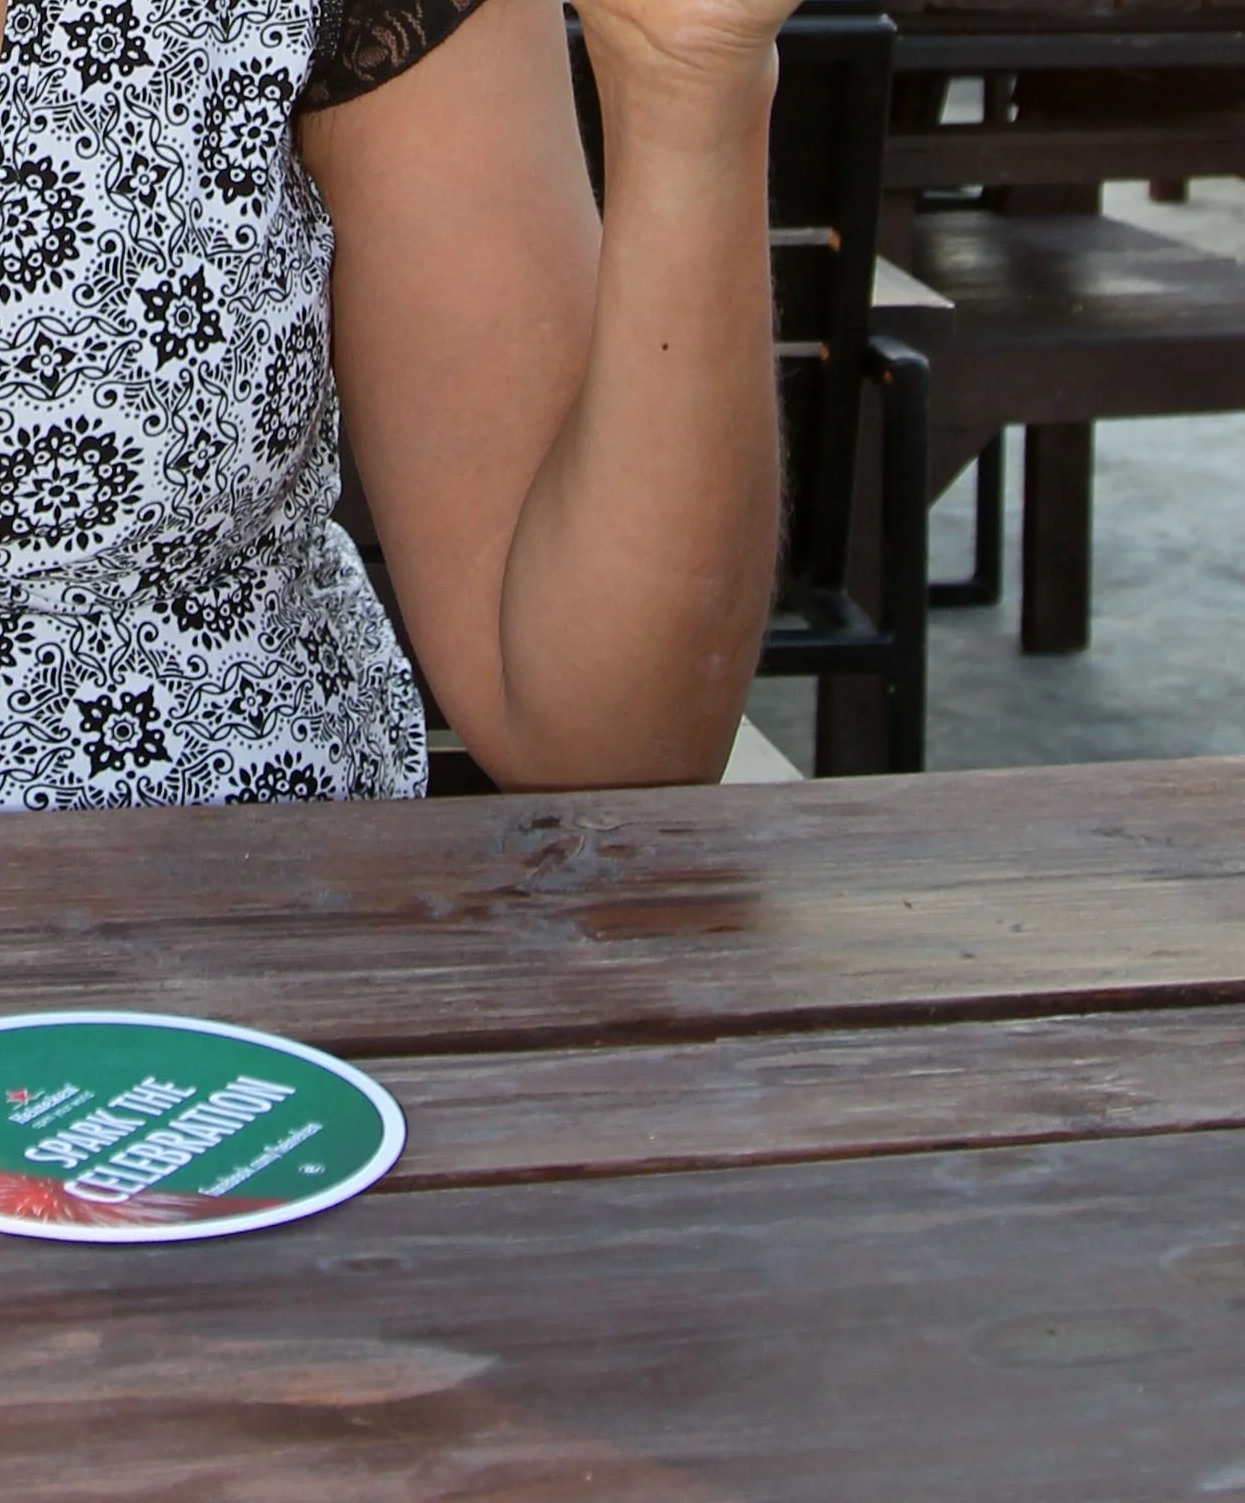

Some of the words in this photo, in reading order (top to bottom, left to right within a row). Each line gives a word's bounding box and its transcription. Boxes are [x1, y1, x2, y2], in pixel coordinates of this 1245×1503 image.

[24, 1107, 146, 1169] SPARK
[107, 1076, 197, 1116] THE
[63, 1075, 296, 1204] CELEBRATION
